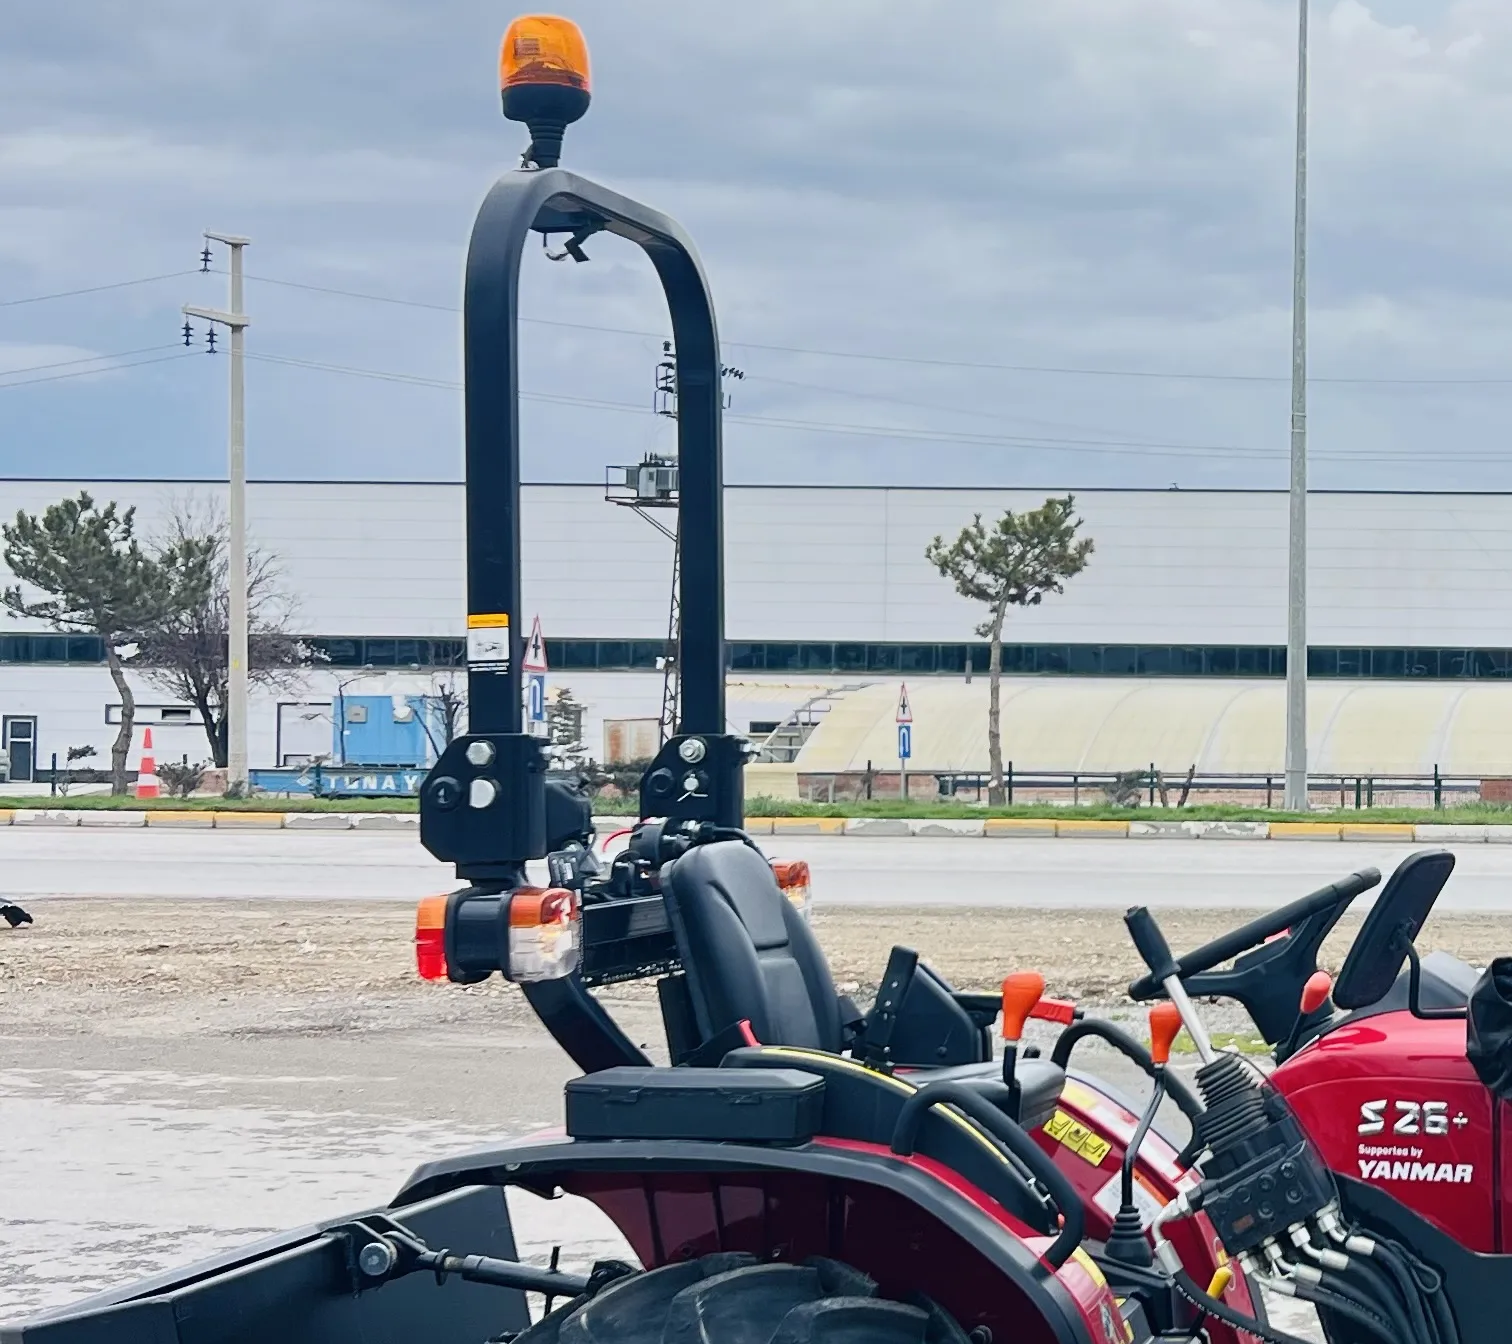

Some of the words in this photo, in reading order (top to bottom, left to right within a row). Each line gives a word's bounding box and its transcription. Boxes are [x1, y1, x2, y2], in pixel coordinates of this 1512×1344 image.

[1358, 1143, 1409, 1157] Supported
[1410, 1146, 1424, 1158] by
[1358, 1159, 1474, 1183] YANMAR
